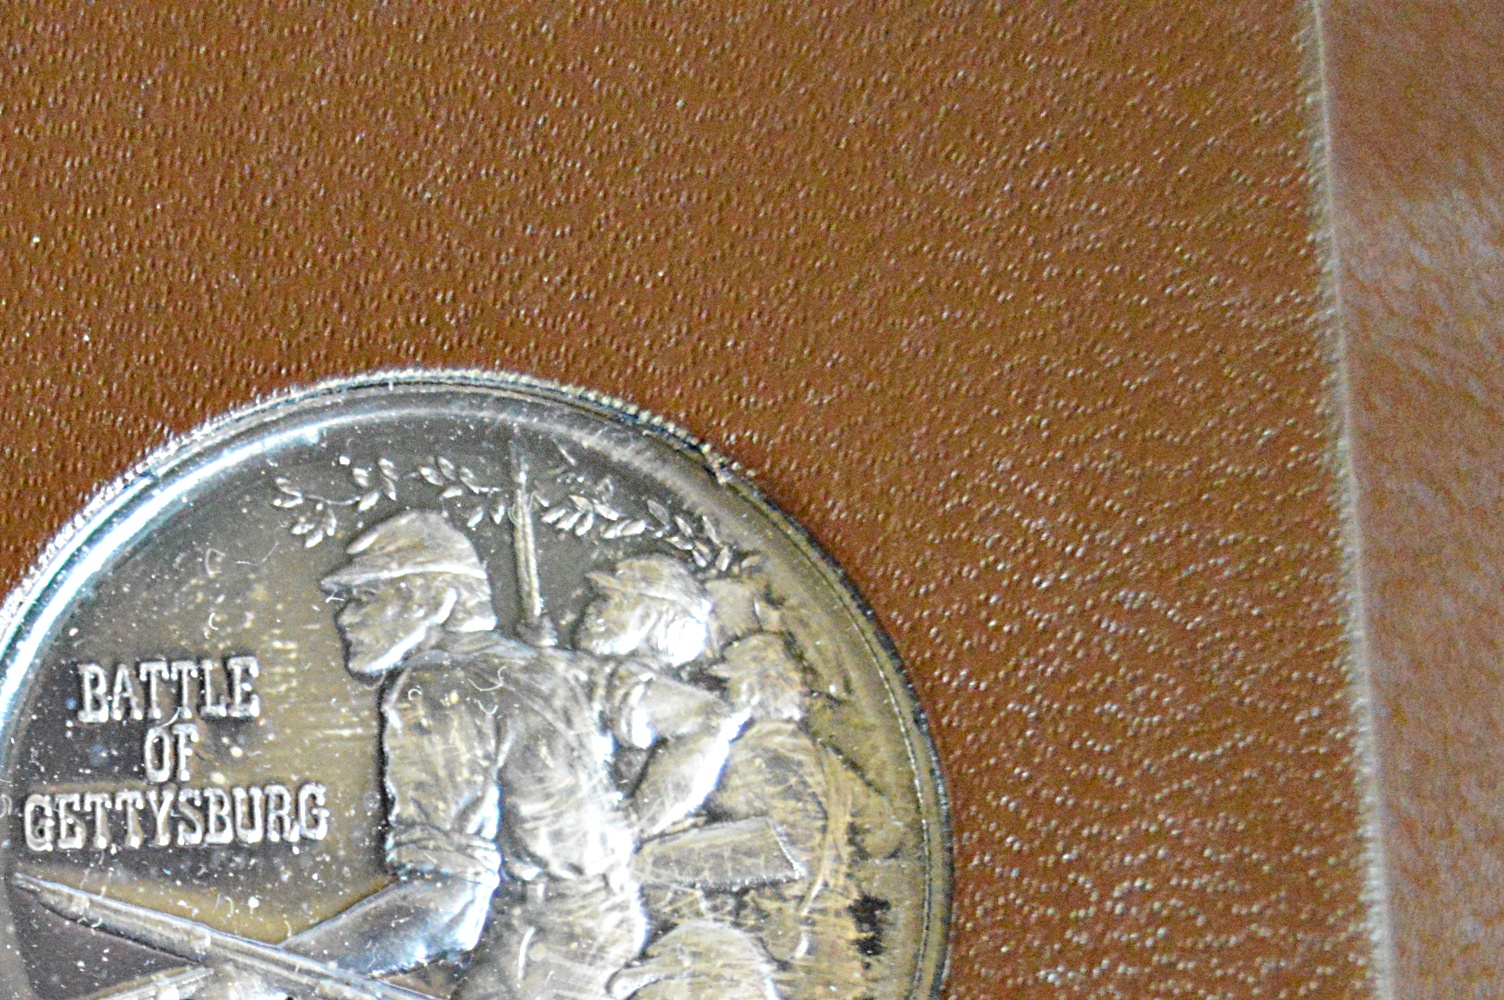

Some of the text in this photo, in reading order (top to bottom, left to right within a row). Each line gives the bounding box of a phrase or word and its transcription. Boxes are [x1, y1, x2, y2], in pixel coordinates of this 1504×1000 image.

[76, 655, 261, 724] BATTLE
[144, 722, 200, 784] OF
[23, 783, 331, 852] GETTYSBURG
